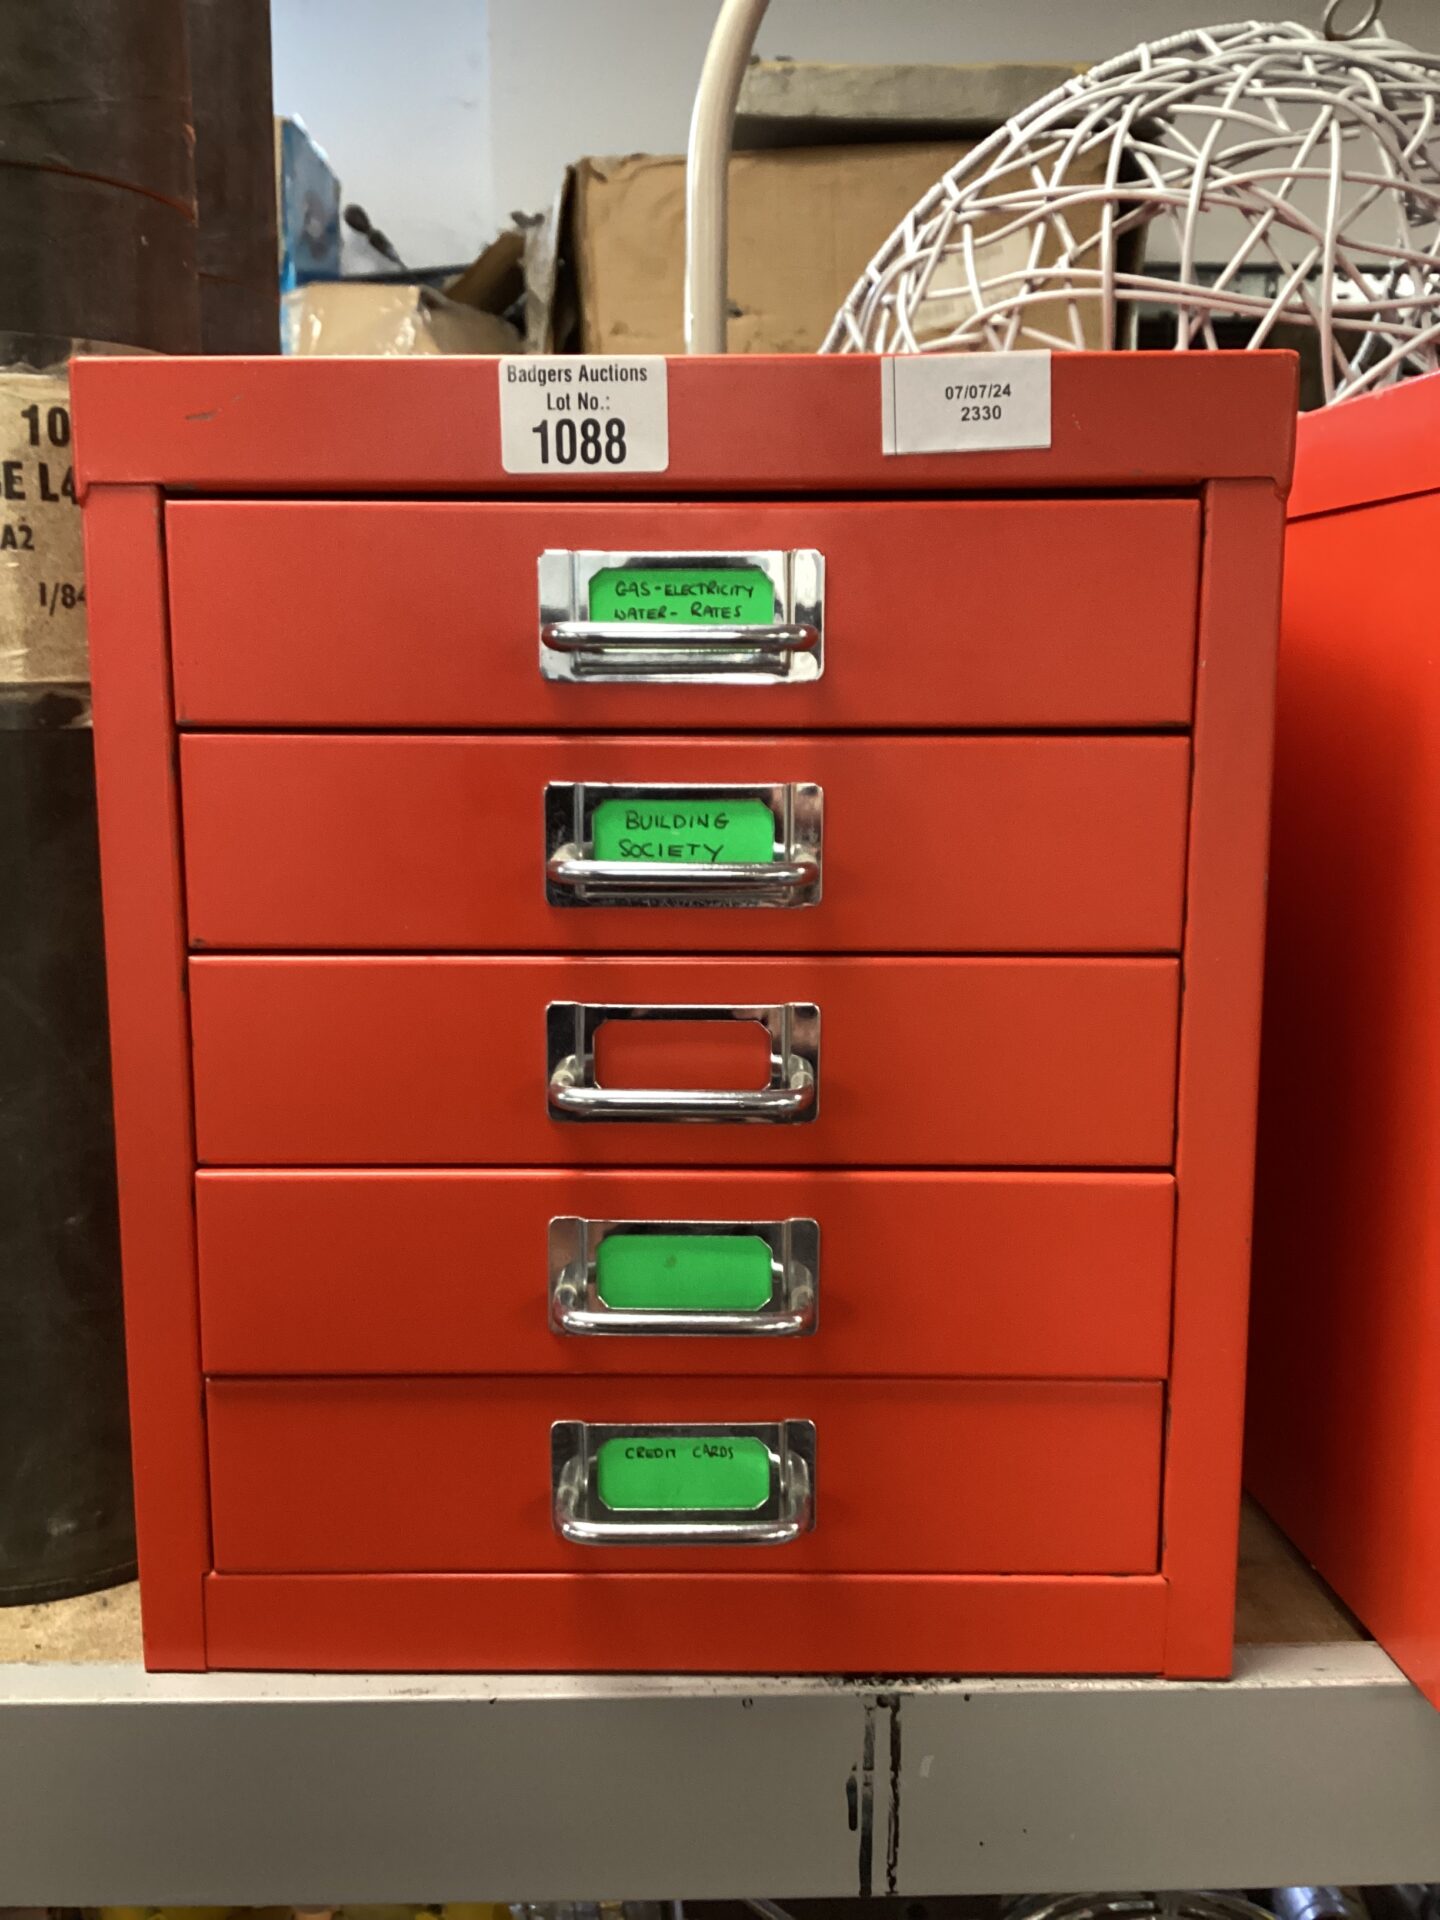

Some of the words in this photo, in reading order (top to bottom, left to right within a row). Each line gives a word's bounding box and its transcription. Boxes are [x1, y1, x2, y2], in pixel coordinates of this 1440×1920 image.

[507, 364, 573, 387] Badgers
[578, 364, 648, 383] Auctions
[945, 383, 1012, 400] 07/07/24
[547, 392, 571, 411] Lot
[961, 405, 1002, 422] 2330
[532, 417, 627, 466] 1088
[690, 601, 743, 619] RATES
[625, 810, 730, 831] BUILDING
[618, 839, 724, 862] SOCIETY
[692, 1444, 735, 1459] CARDS
